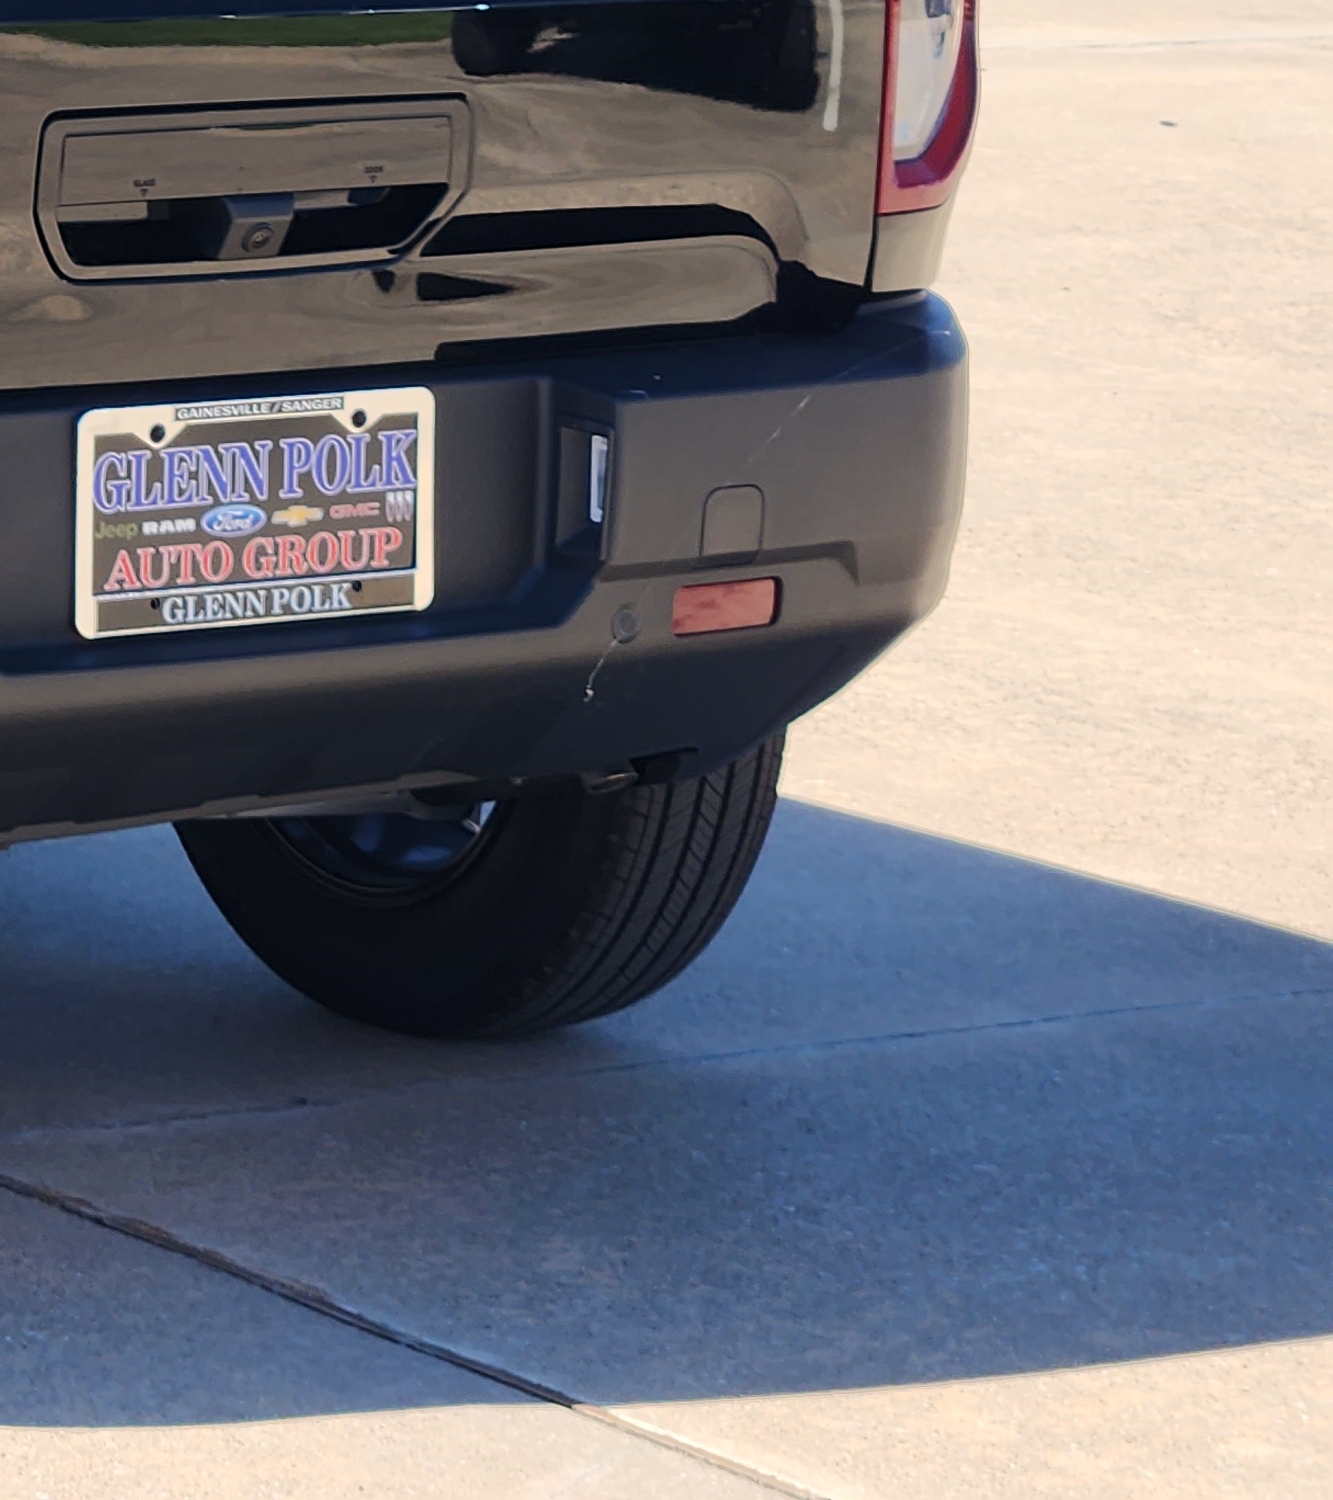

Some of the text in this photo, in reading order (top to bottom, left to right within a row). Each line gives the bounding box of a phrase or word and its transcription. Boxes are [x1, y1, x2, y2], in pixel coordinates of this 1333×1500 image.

[92, 429, 418, 515] GLENN POLK
[95, 502, 381, 540] Jeep RAM Ford GMC
[103, 526, 403, 592] AUTO GROUP
[161, 583, 353, 625] GLENN POLK
